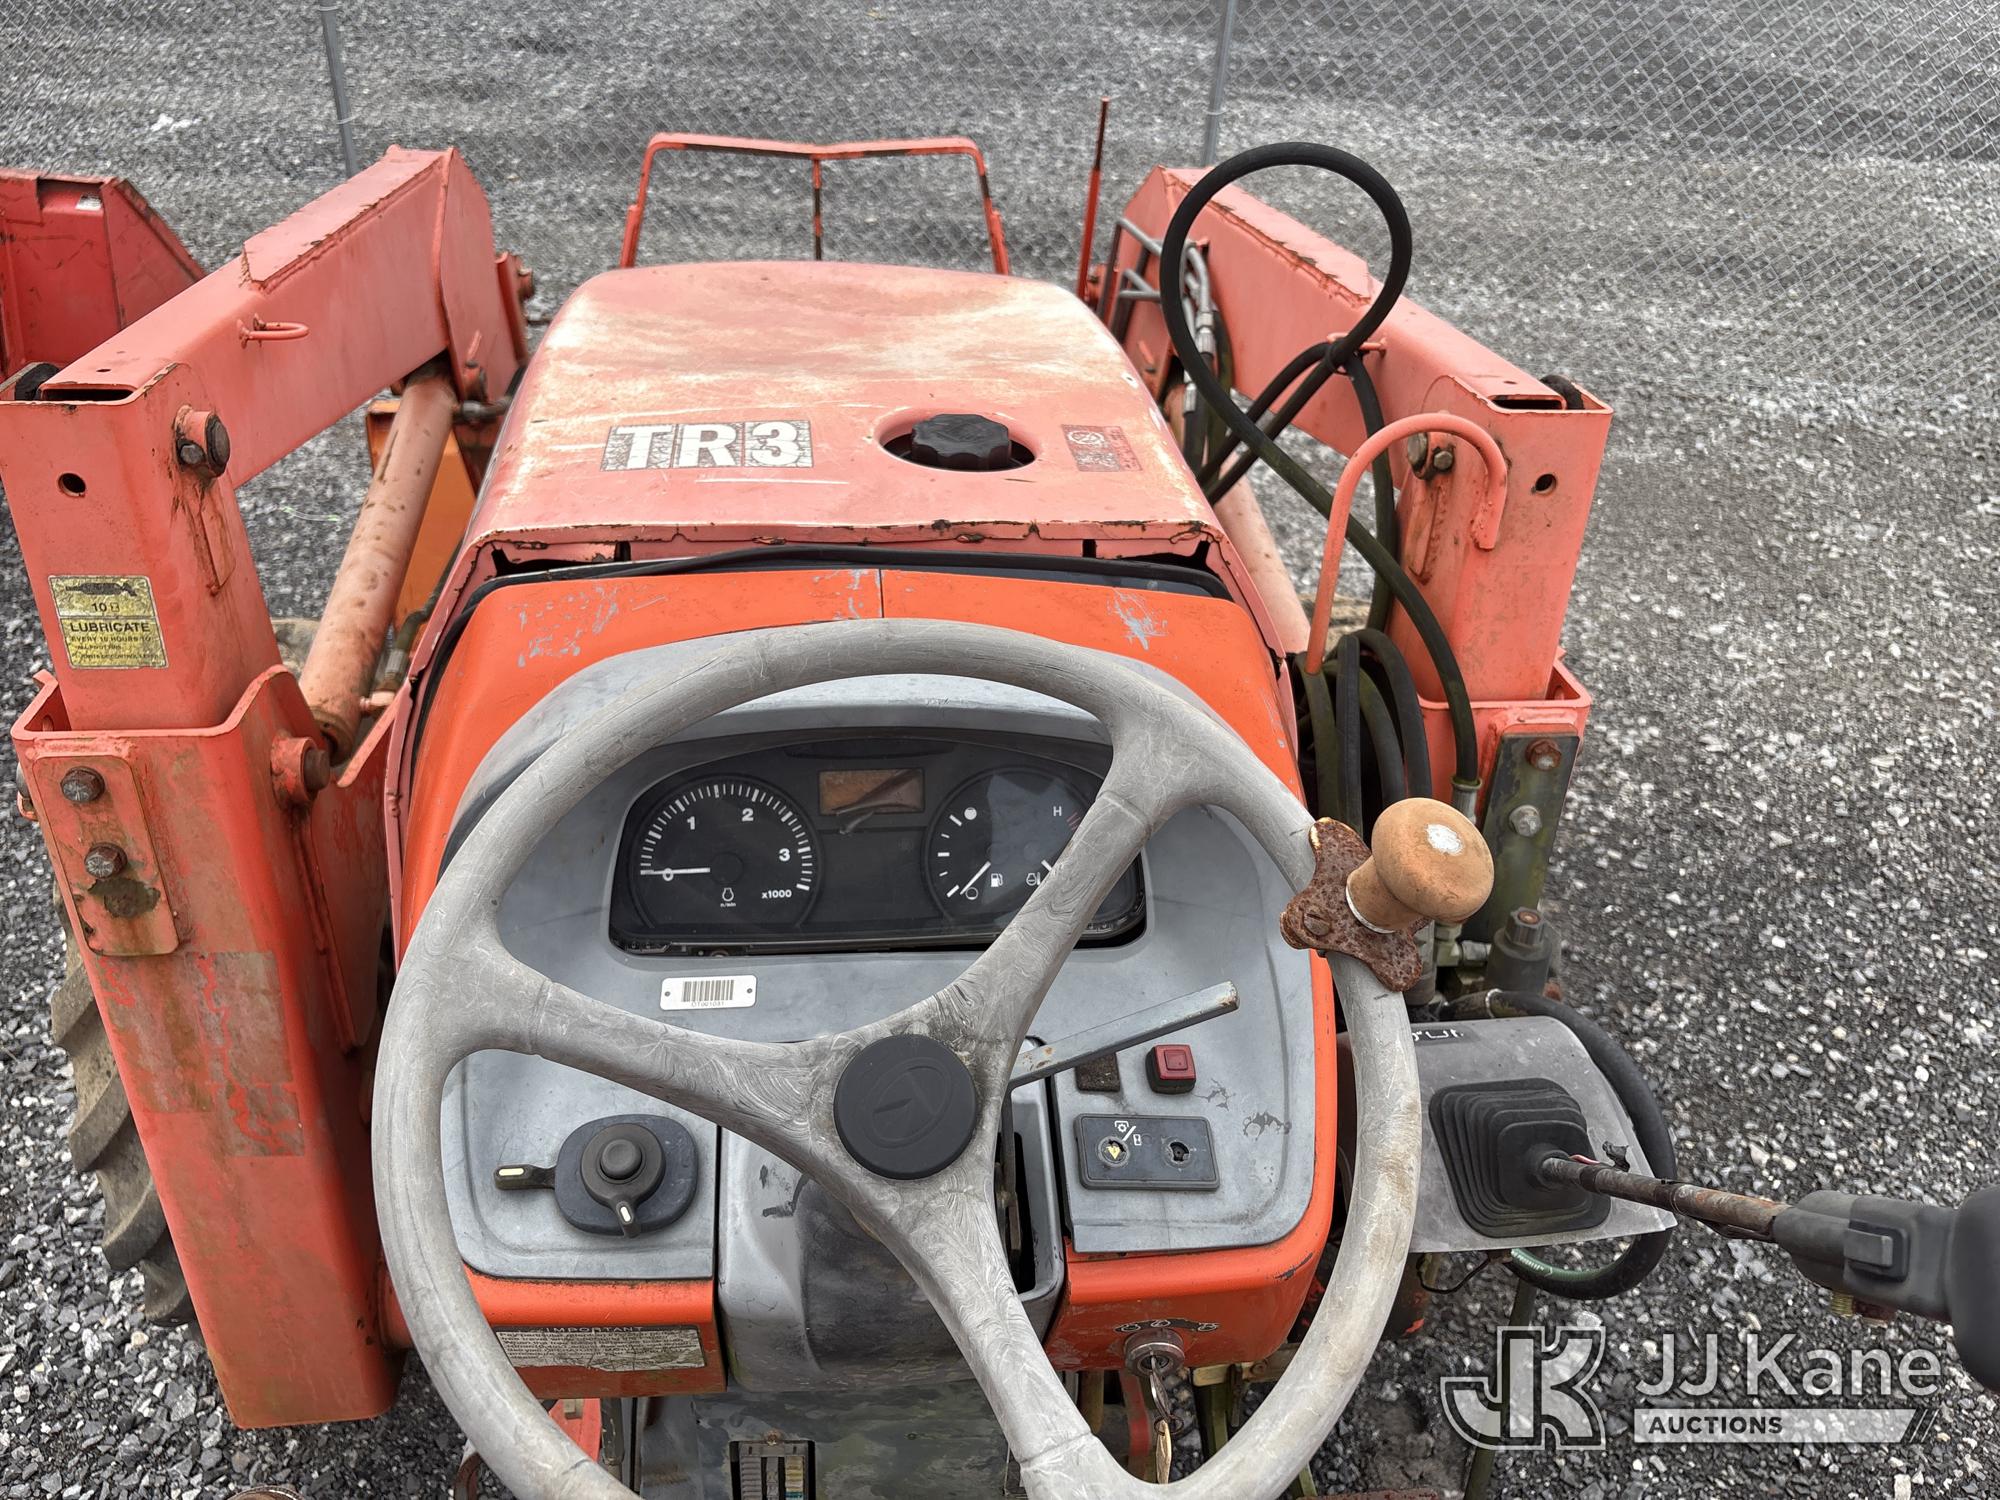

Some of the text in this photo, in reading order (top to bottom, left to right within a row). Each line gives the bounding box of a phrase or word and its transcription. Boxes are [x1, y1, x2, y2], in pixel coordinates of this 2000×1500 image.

[616, 421, 801, 469] TR3
[92, 602, 107, 612] 10
[70, 622, 150, 632] LUBRICATE
[742, 808, 754, 822] 2
[1053, 806, 1062, 816] H
[687, 816, 696, 830] 1
[779, 848, 791, 862] 3
[761, 889, 792, 899] x1000
